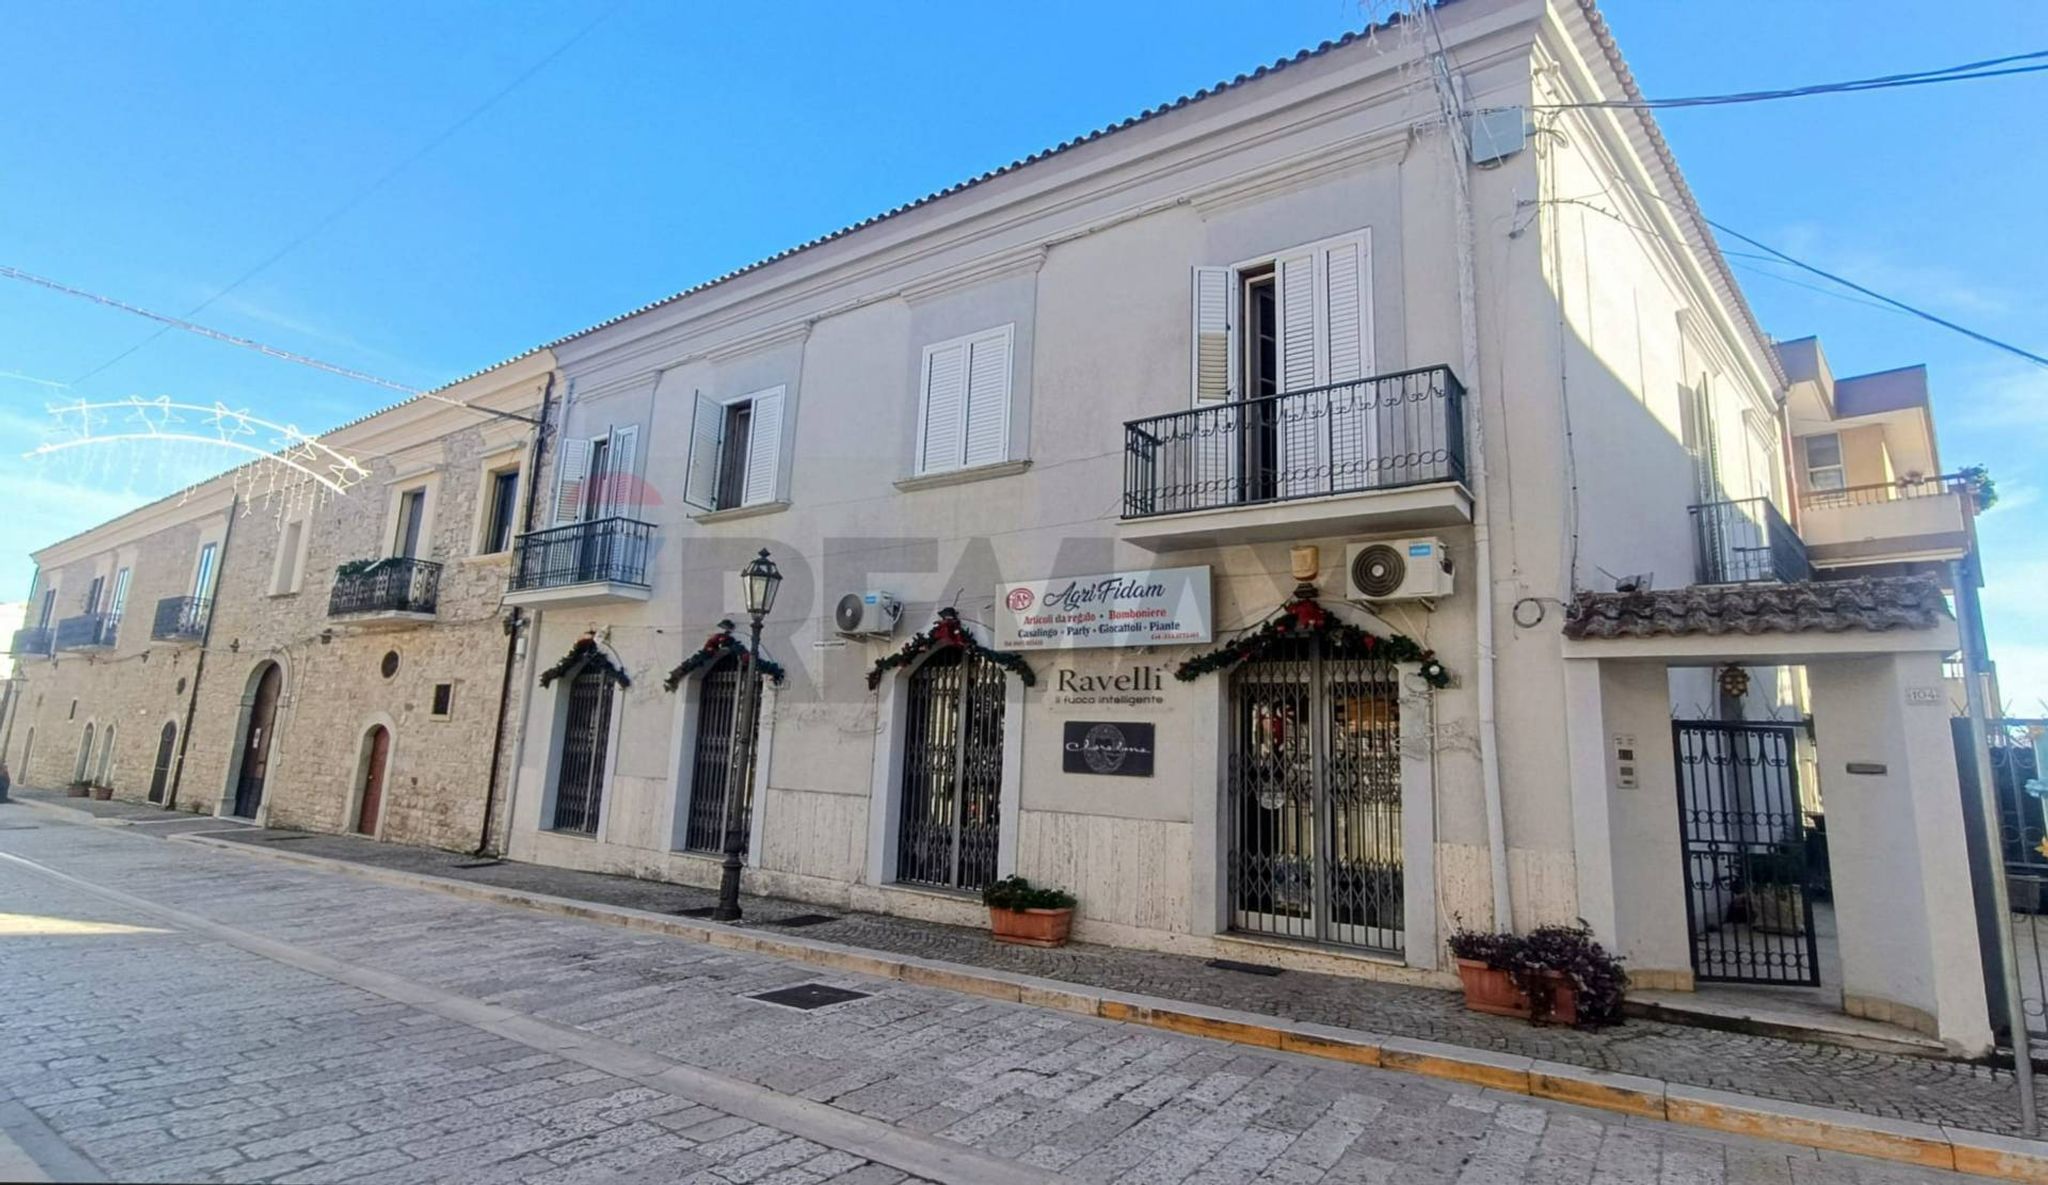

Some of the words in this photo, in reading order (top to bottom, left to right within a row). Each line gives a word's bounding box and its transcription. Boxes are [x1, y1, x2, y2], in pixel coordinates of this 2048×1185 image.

[1024, 615, 1053, 625] Articoli
[1055, 614, 1066, 623] da
[1067, 611, 1096, 624] regalo
[1108, 607, 1168, 620] Bomboniere
[1018, 626, 1058, 639] Casalingo
[1066, 625, 1091, 637] Party
[1098, 622, 1142, 634] Giocattoli
[1149, 620, 1181, 632] Piante
[1058, 666, 1162, 693] Ravelli
[1063, 695, 1096, 704] fuoco
[1098, 695, 1164, 707] intelligente
